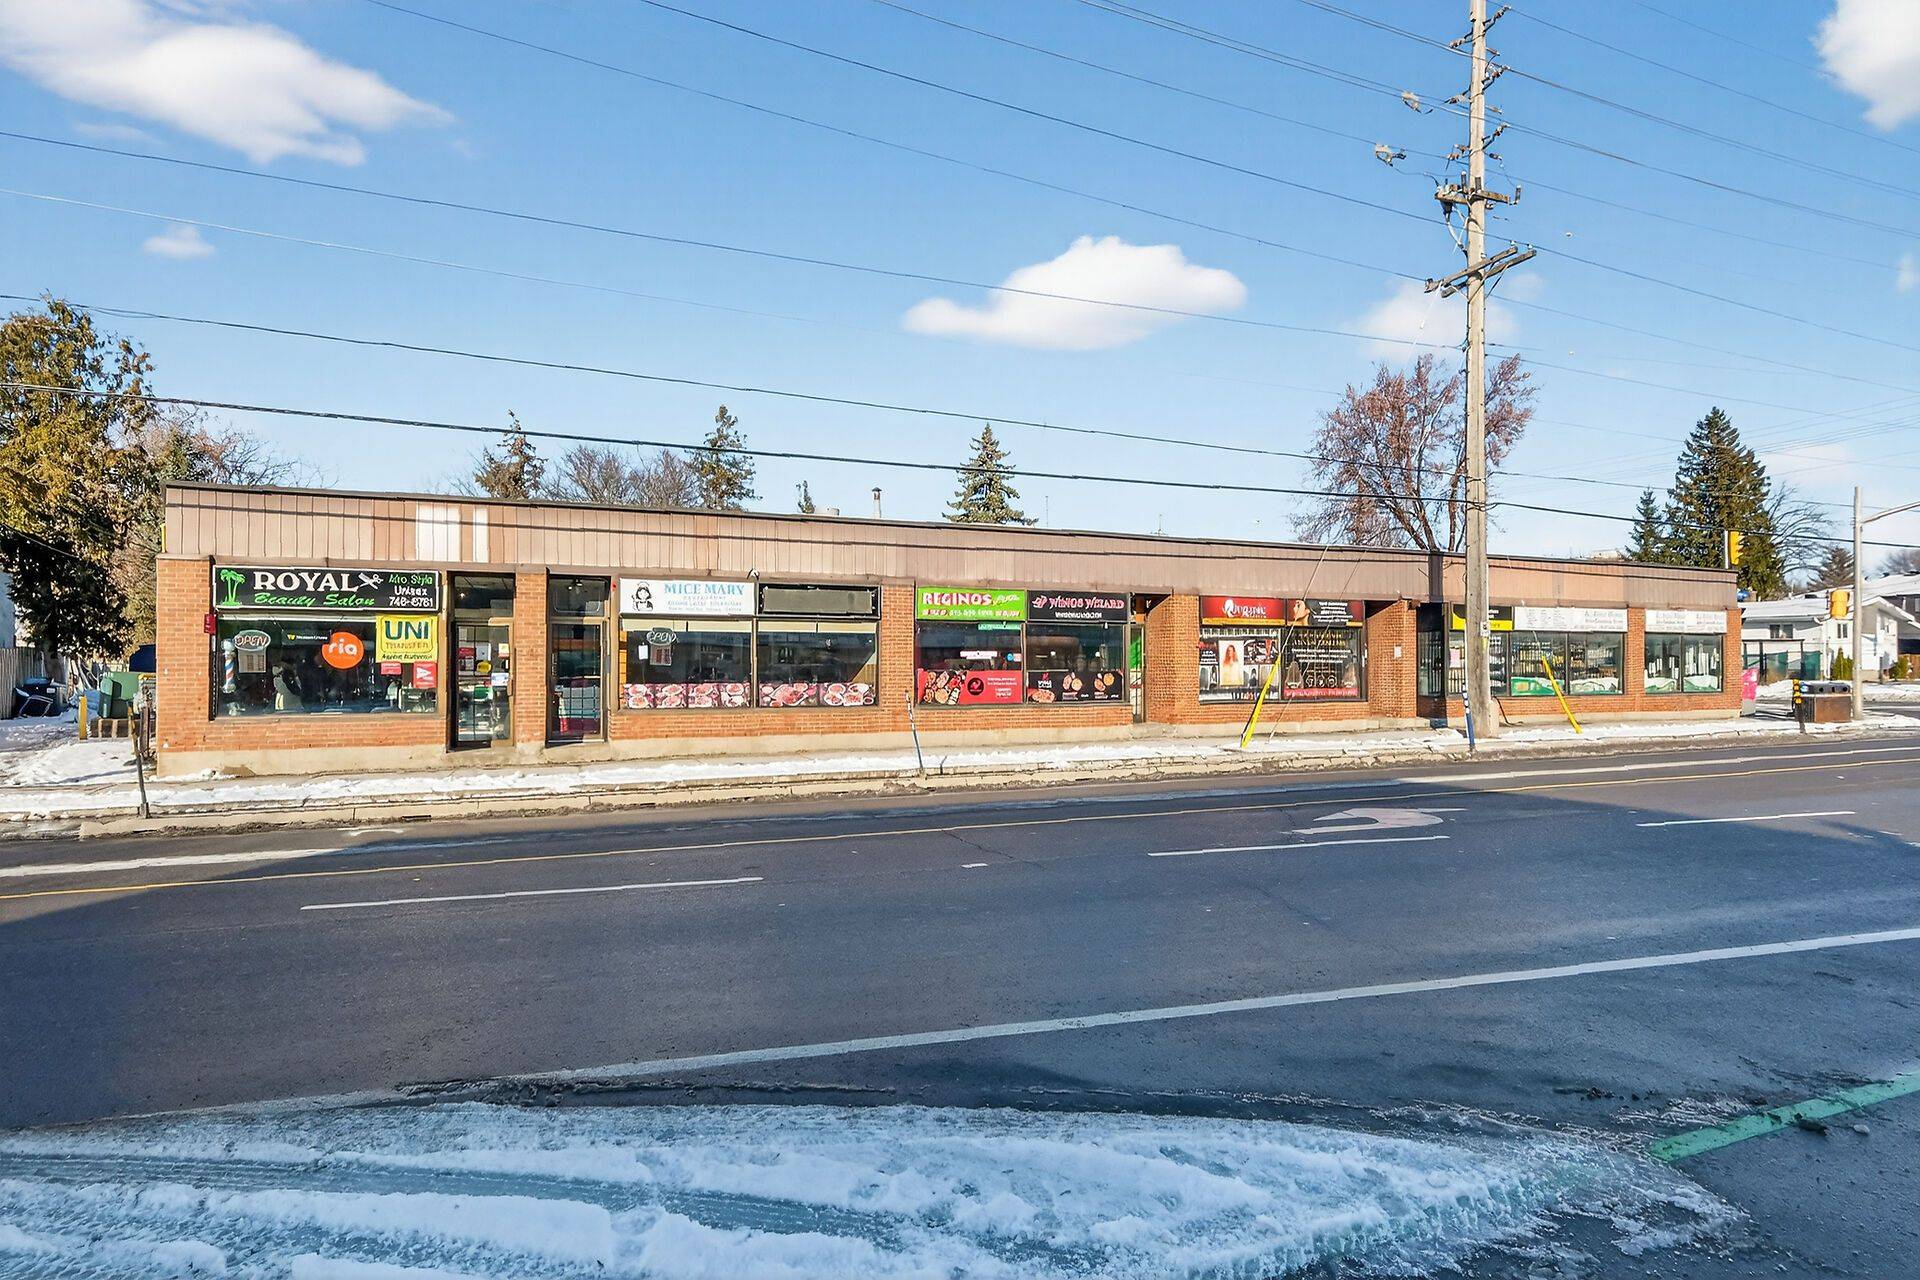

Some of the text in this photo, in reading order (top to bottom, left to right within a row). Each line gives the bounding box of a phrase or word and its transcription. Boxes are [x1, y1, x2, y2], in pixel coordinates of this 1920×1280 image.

[253, 571, 358, 592] ROYAL
[411, 574, 433, 586] Style
[704, 583, 744, 596] MARY
[254, 592, 375, 608] Beauty Salon
[385, 620, 429, 640] UNI
[235, 635, 267, 646] OPEN
[328, 637, 357, 656] ria
